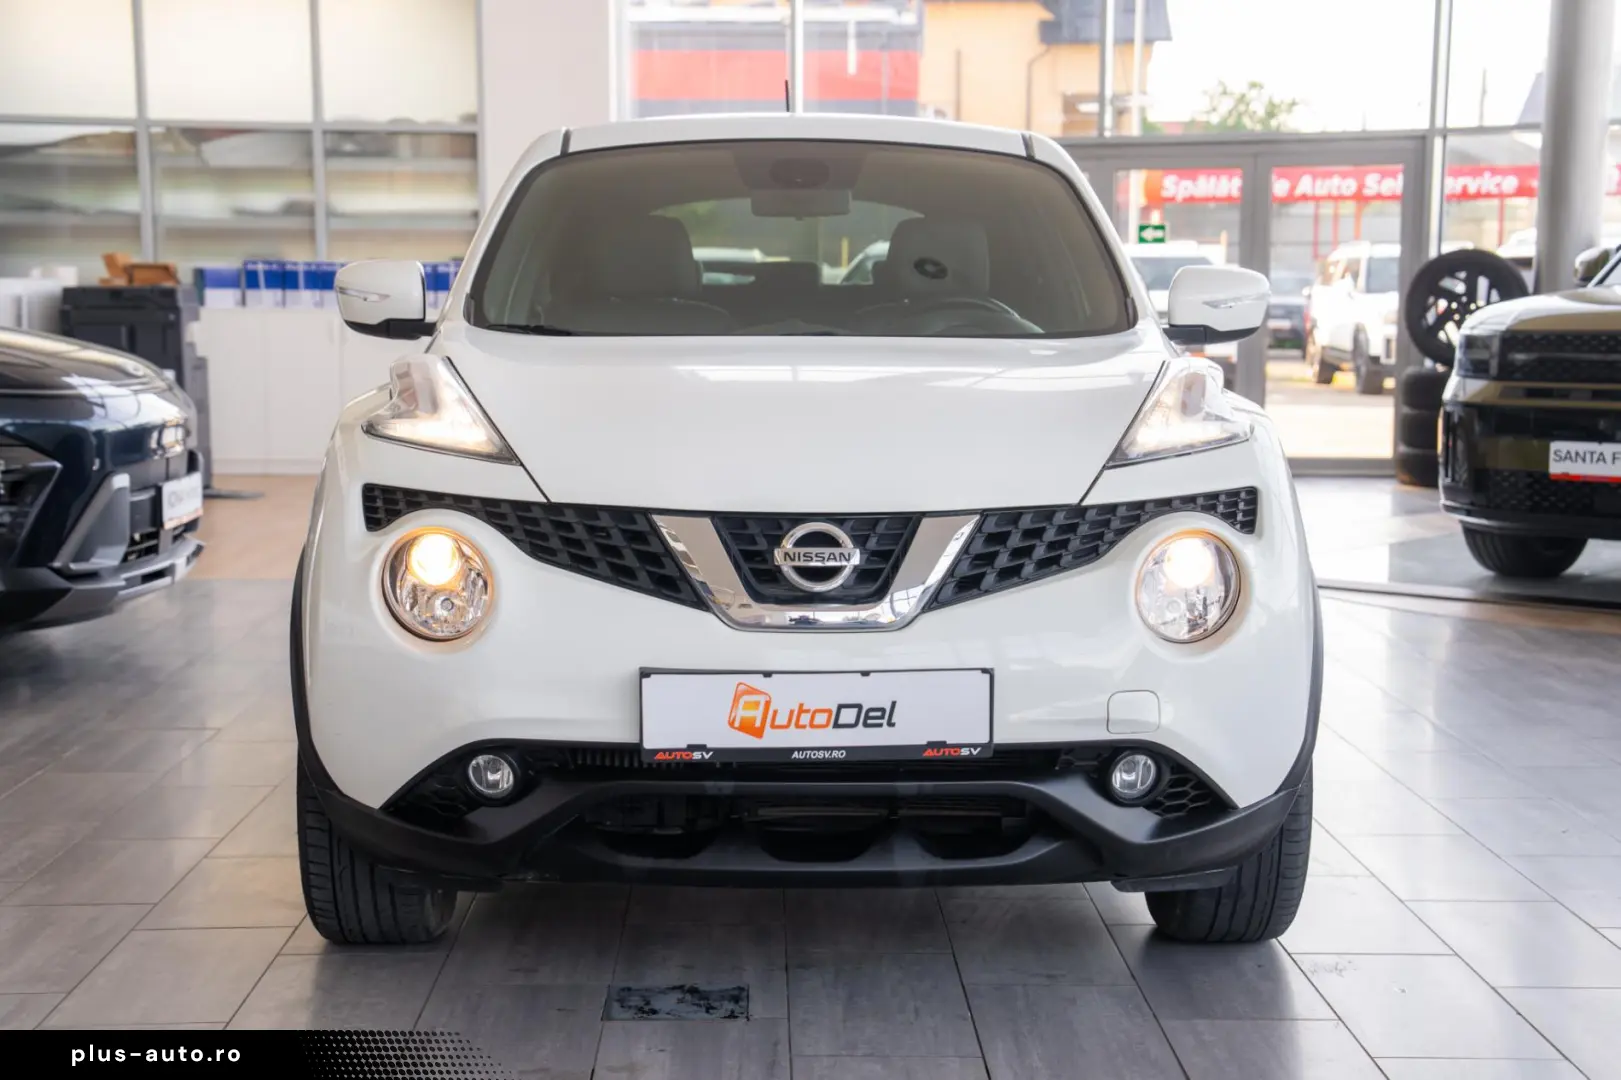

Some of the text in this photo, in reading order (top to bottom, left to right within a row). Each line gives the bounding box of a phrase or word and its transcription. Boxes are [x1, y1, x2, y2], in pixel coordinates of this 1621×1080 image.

[1294, 173, 1358, 197] Auto
[1444, 170, 1520, 195] ervice
[1552, 448, 1608, 465] SANTA
[783, 551, 851, 563] NISSAN
[731, 688, 897, 735] AutoDel
[653, 751, 714, 760] AUTOSV
[791, 750, 846, 760] AUTOSV.RO
[922, 747, 982, 757] AUTOSV
